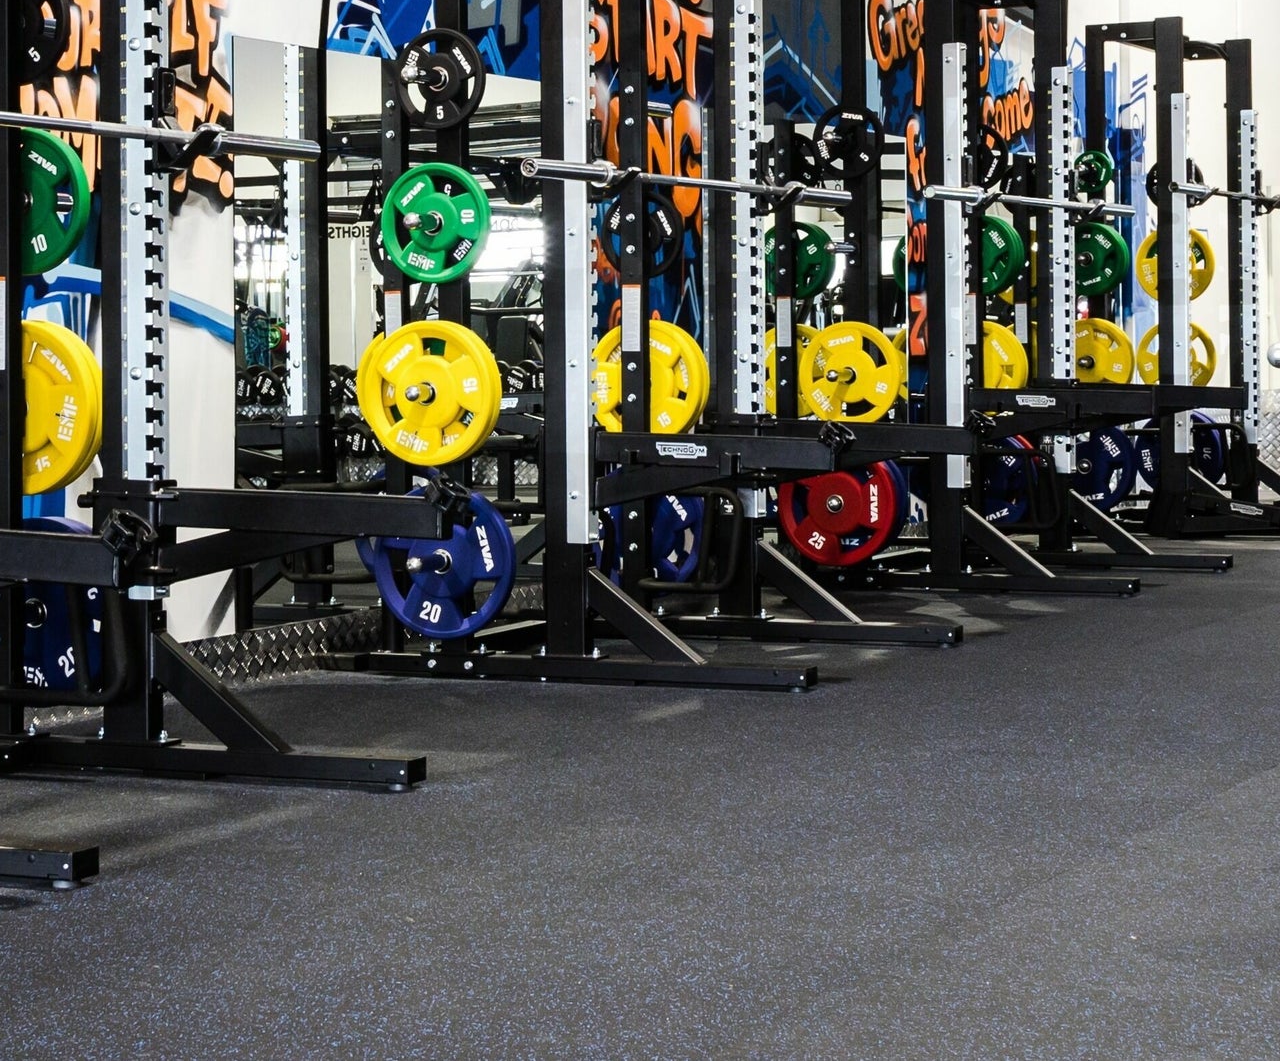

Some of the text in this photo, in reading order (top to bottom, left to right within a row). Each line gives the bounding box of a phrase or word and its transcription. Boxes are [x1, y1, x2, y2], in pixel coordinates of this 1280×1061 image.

[27, 46, 41, 62] 5
[452, 46, 472, 75] ZIVA
[436, 105, 444, 120] 5
[841, 112, 864, 121] ZIVA
[28, 150, 58, 176] ZIVA
[859, 151, 870, 162] 5
[390, 181, 426, 208] ZIVA
[460, 208, 476, 225] 10
[656, 209, 674, 236] ZIVA
[30, 233, 48, 255] 10
[407, 251, 436, 271] EMF
[827, 335, 855, 348] ZIVA
[462, 377, 478, 394] 15
[875, 381, 889, 394] 15
[811, 387, 835, 413] EMF
[56, 394, 78, 442] EMF
[656, 411, 673, 429] 15
[396, 429, 429, 454] EMF
[34, 455, 51, 473] 15
[869, 483, 879, 524] ZIVA
[475, 525, 494, 573] ZIVA
[808, 530, 827, 551] 25
[419, 600, 442, 624] 20
